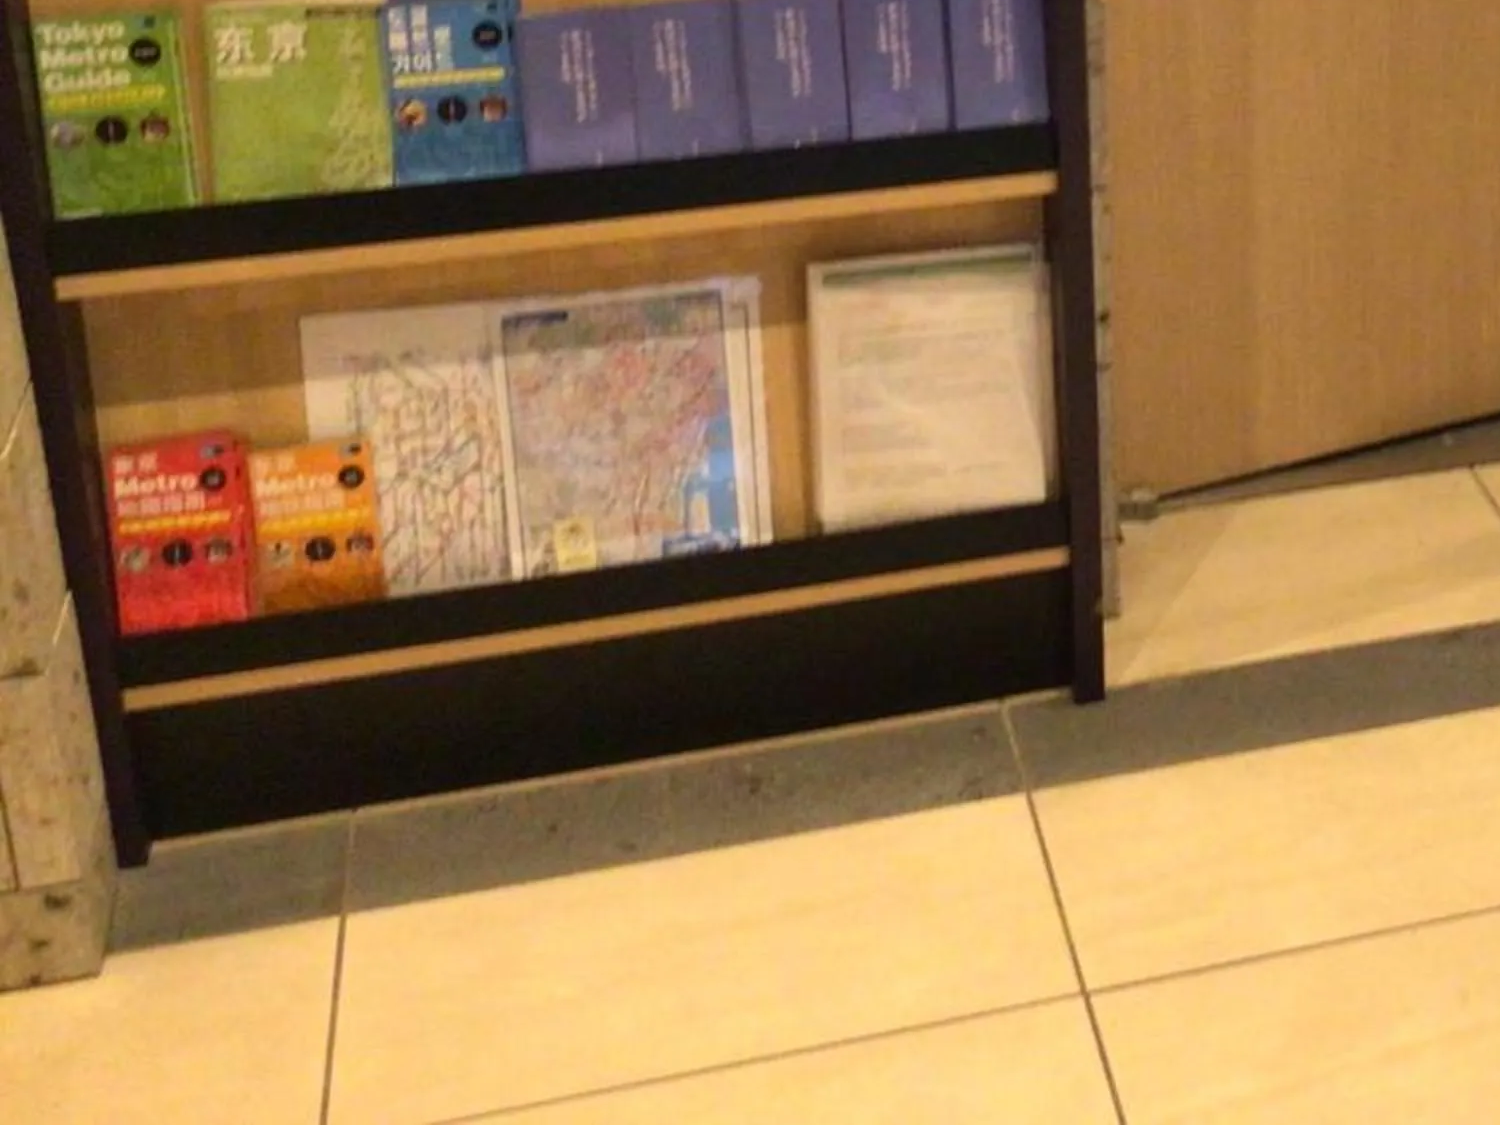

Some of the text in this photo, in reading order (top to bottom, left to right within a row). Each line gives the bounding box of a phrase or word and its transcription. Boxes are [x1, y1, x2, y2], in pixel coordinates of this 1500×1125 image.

[34, 20, 126, 44] Tokyo
[213, 23, 307, 65] 东京
[40, 44, 130, 70] Metro
[44, 66, 132, 93] Guide
[114, 472, 199, 499] Metro
[255, 471, 338, 497] Metro
